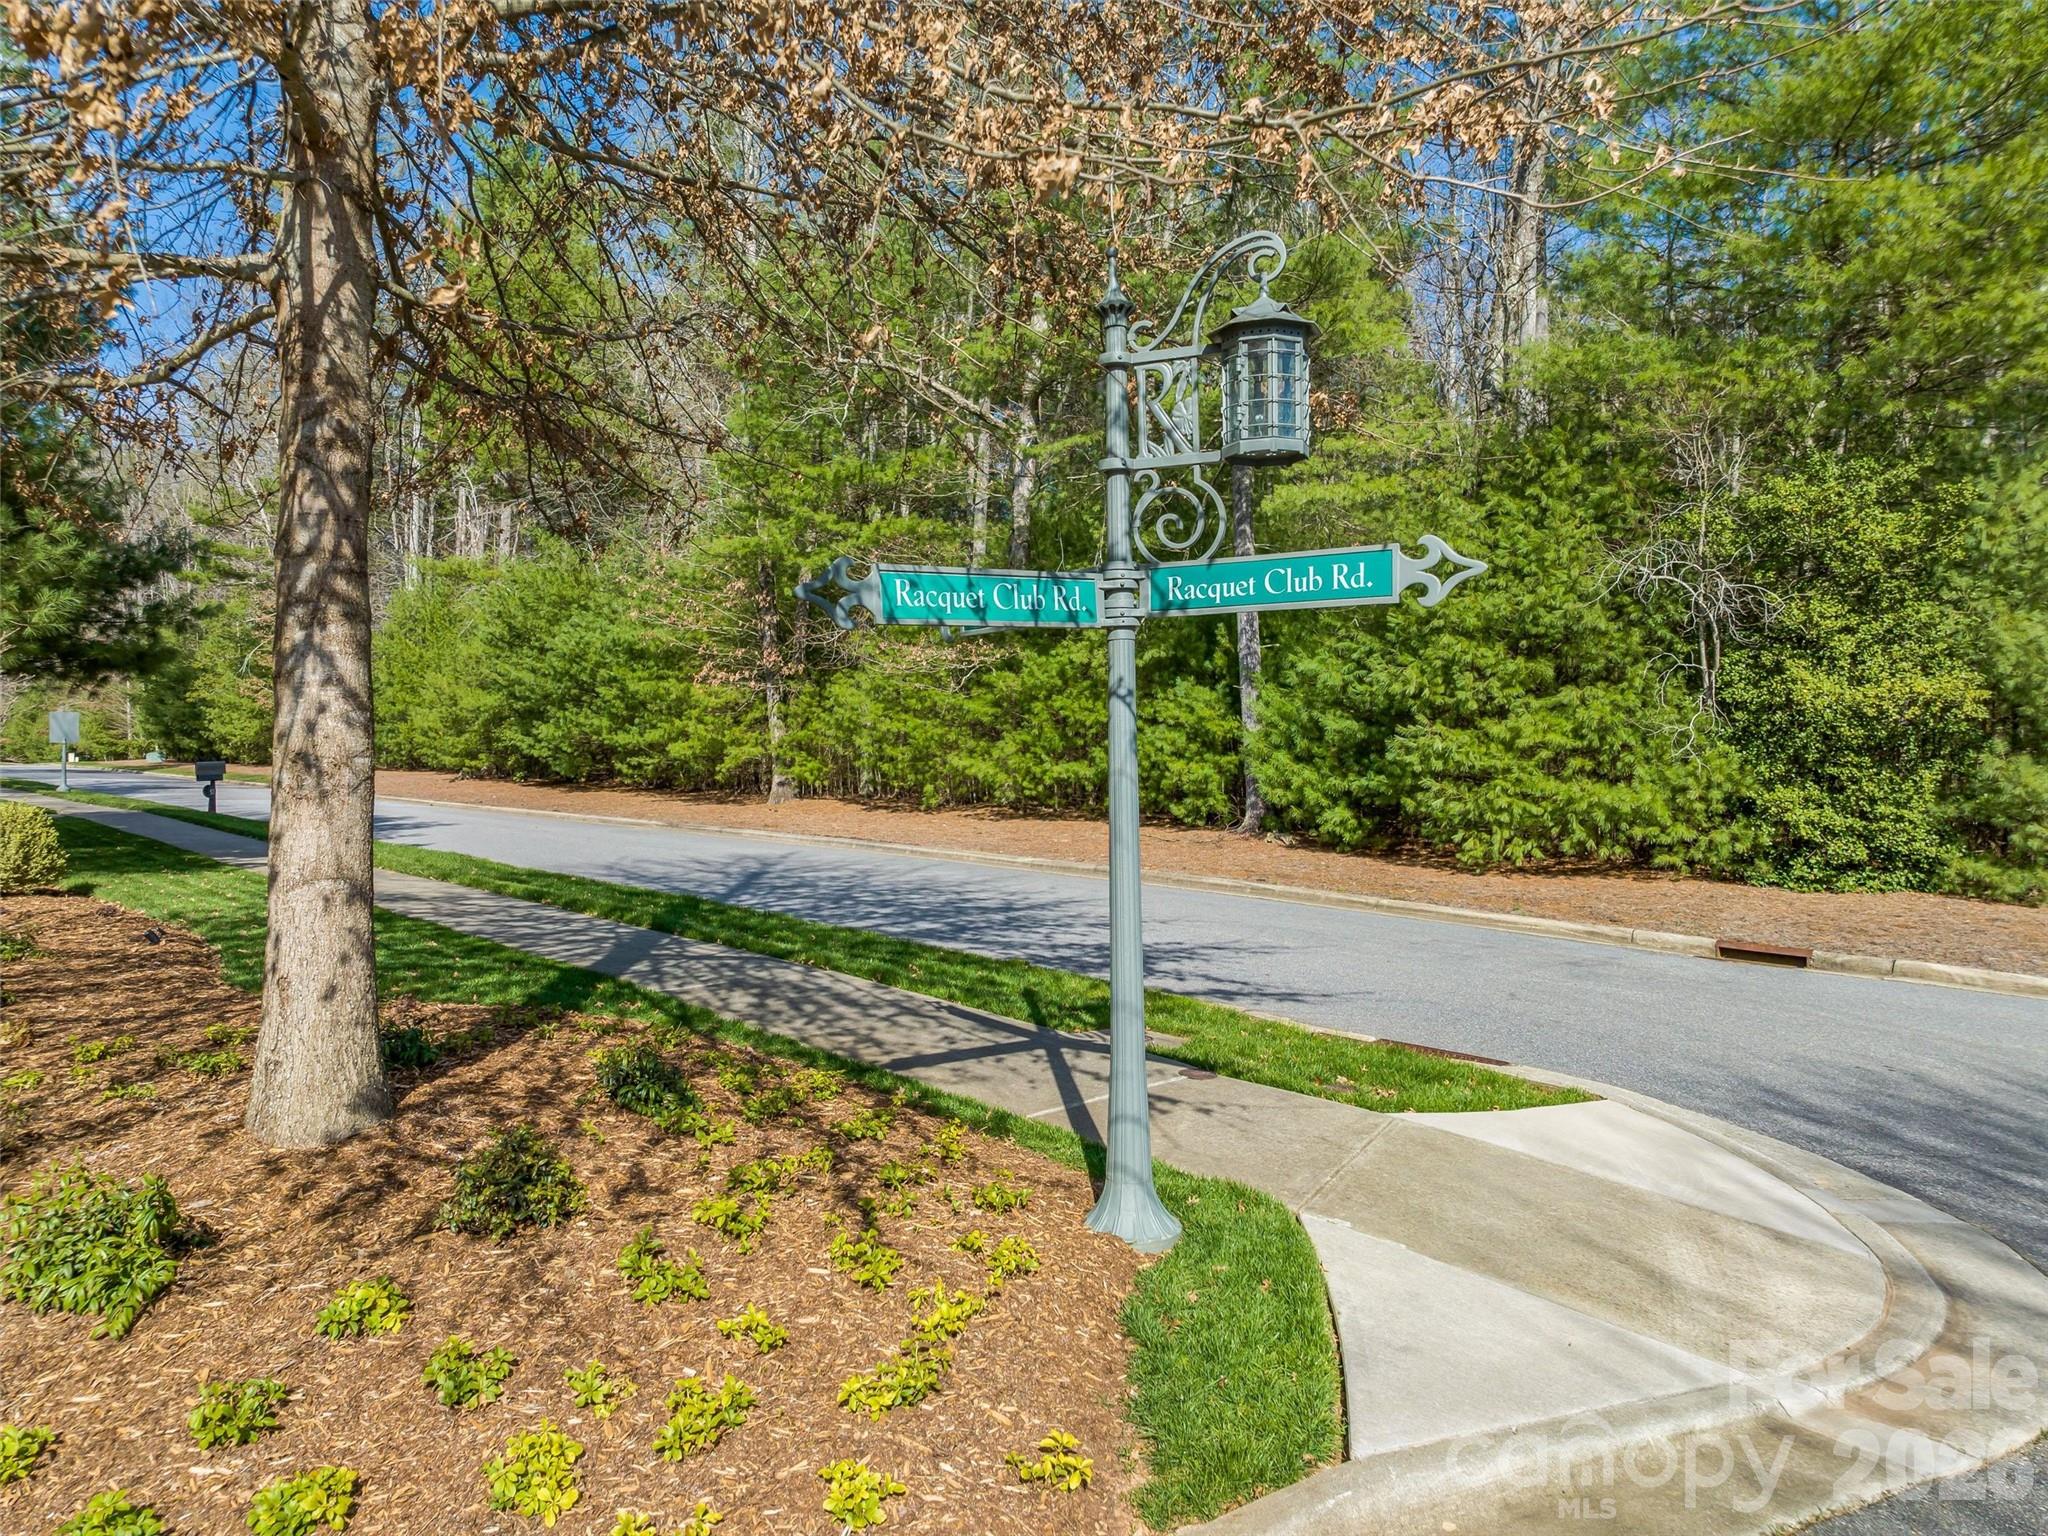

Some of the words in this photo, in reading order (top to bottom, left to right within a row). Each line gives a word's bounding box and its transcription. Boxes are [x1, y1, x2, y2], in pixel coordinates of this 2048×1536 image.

[1134, 362, 1194, 457] R
[894, 578, 985, 614] Racquet
[993, 582, 1046, 611] Club
[1053, 585, 1088, 612] Rd.
[1167, 575, 1256, 604] Racquet
[1264, 565, 1323, 595] Club
[1331, 561, 1374, 591] Rd.
